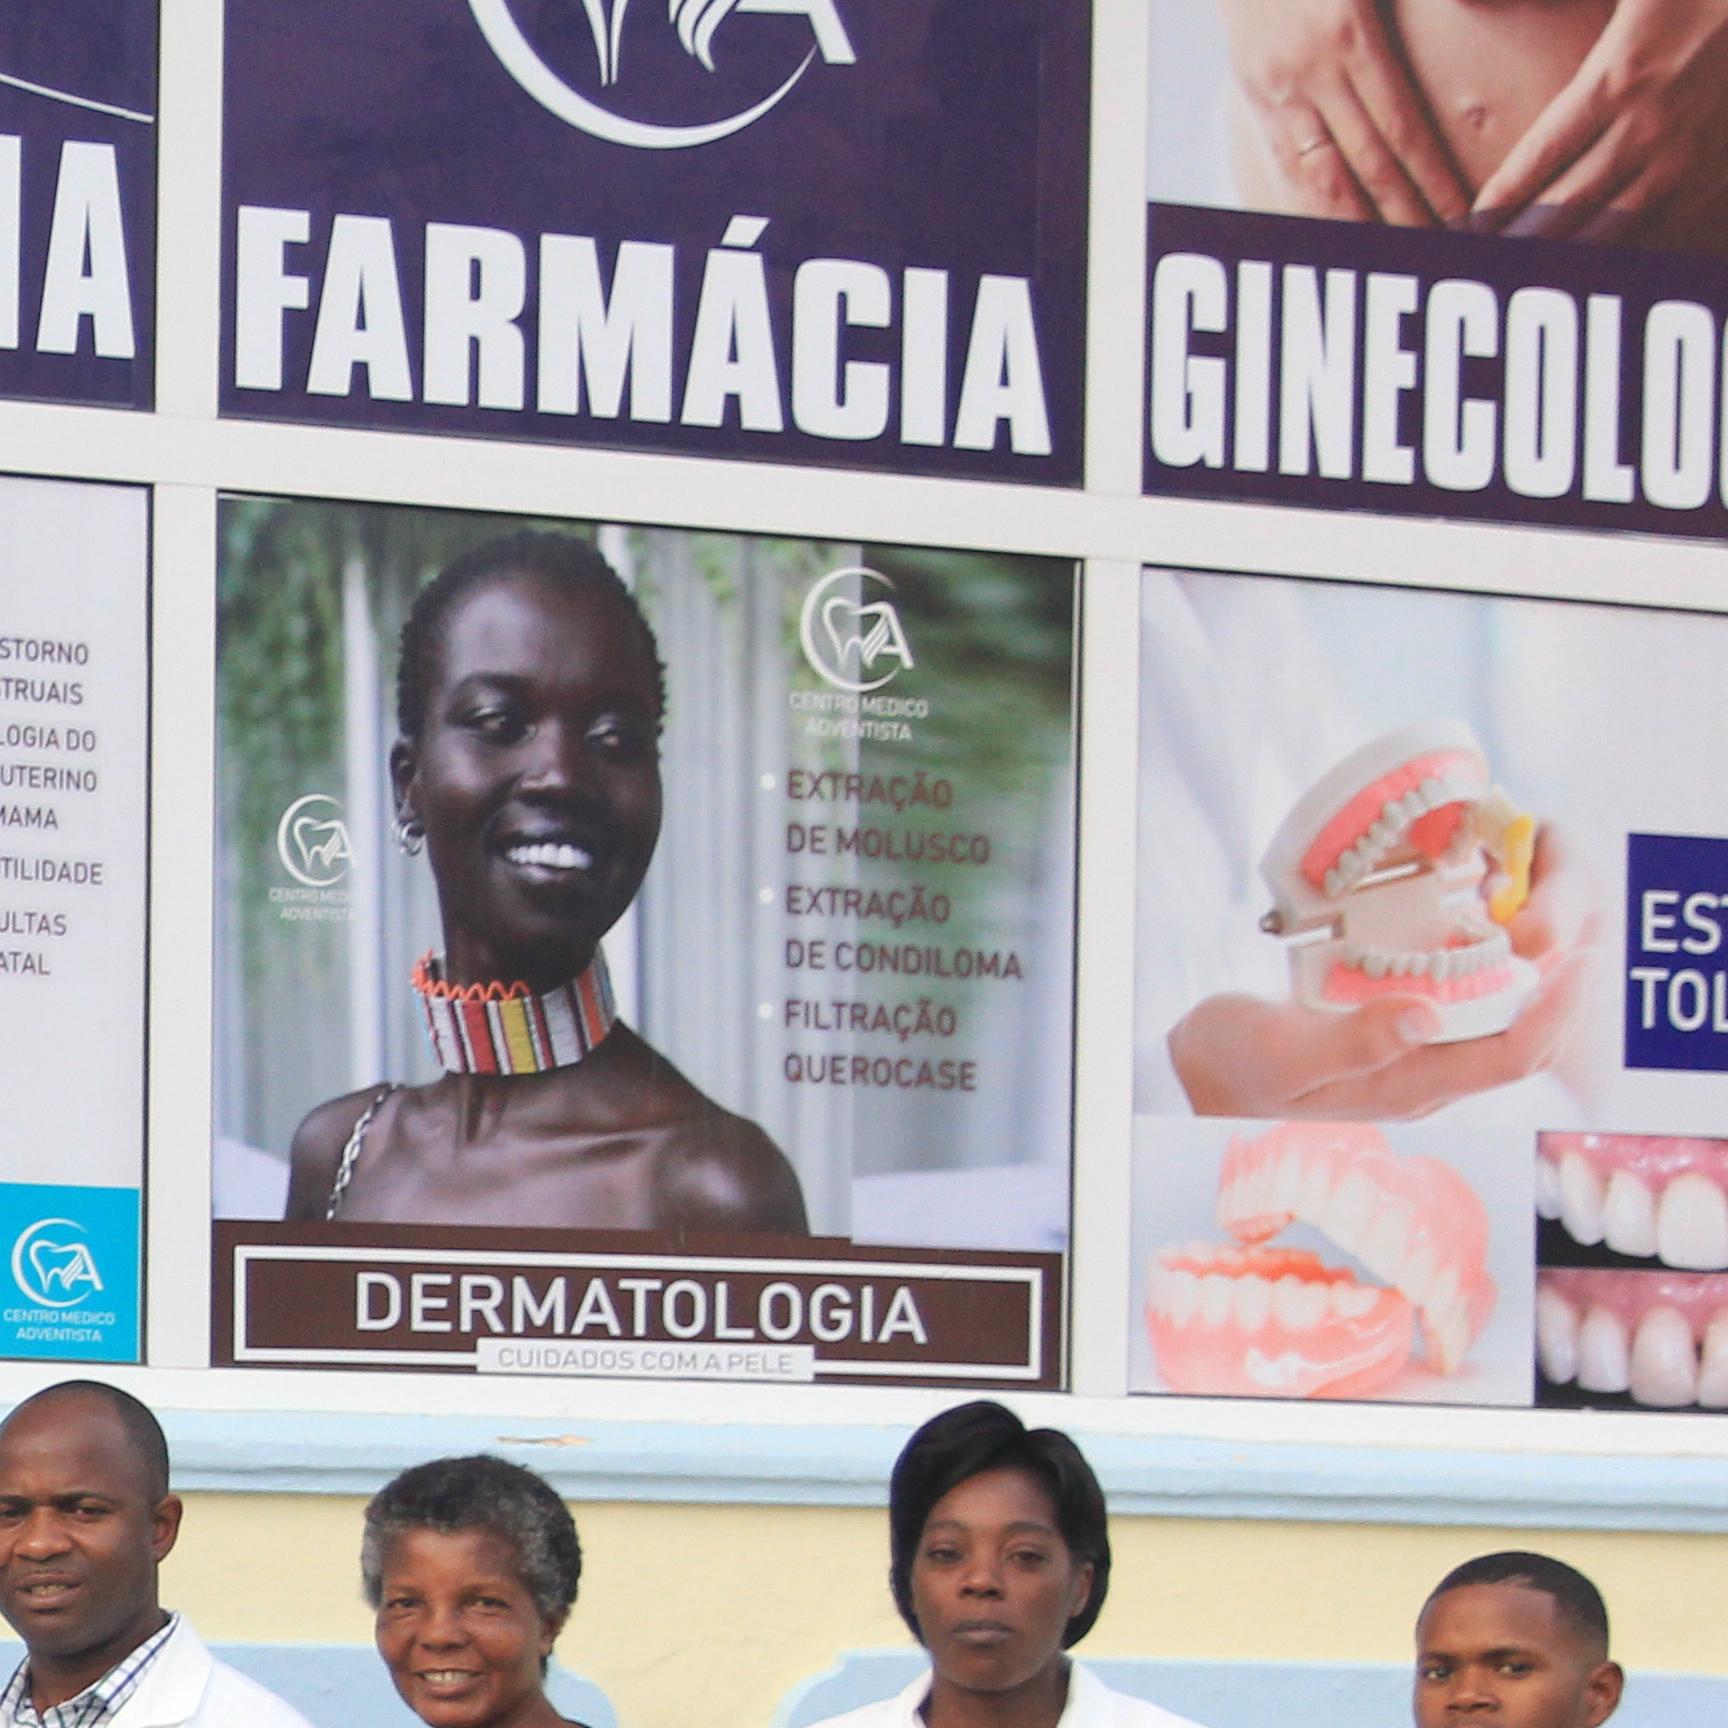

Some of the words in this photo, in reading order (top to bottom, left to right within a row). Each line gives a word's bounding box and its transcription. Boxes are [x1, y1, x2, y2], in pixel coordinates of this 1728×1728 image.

[235, 205, 1052, 456] FARMÁCIA
[1151, 252, 1728, 509] GINECOLO
[861, 696, 929, 719] MEDICO
[66, 729, 97, 753] DO
[805, 717, 913, 742] ADVENTISTA
[0, 764, 98, 793] UTERINO
[786, 767, 955, 814] EXTRAÇÃO
[786, 823, 827, 855] DE
[835, 826, 991, 865] MOLUSCO
[785, 885, 952, 929] EXTRAÇÃO
[1642, 889, 1728, 955] ES
[785, 939, 827, 969] DE
[835, 941, 1023, 979] CONDILOMA
[784, 998, 957, 1041] FILTRAÇÃO
[784, 1053, 977, 1093] QUEROCASE
[3, 1308, 59, 1324] CENTRO
[61, 1310, 115, 1325] MEDICO
[356, 1272, 928, 1344] DERMATOLOGIA
[15, 1327, 103, 1342] ADVENTISTA
[497, 1347, 635, 1371] CUIDADOS
[640, 1350, 697, 1372] COM
[703, 1352, 723, 1373] A
[727, 1352, 793, 1375] PELE
